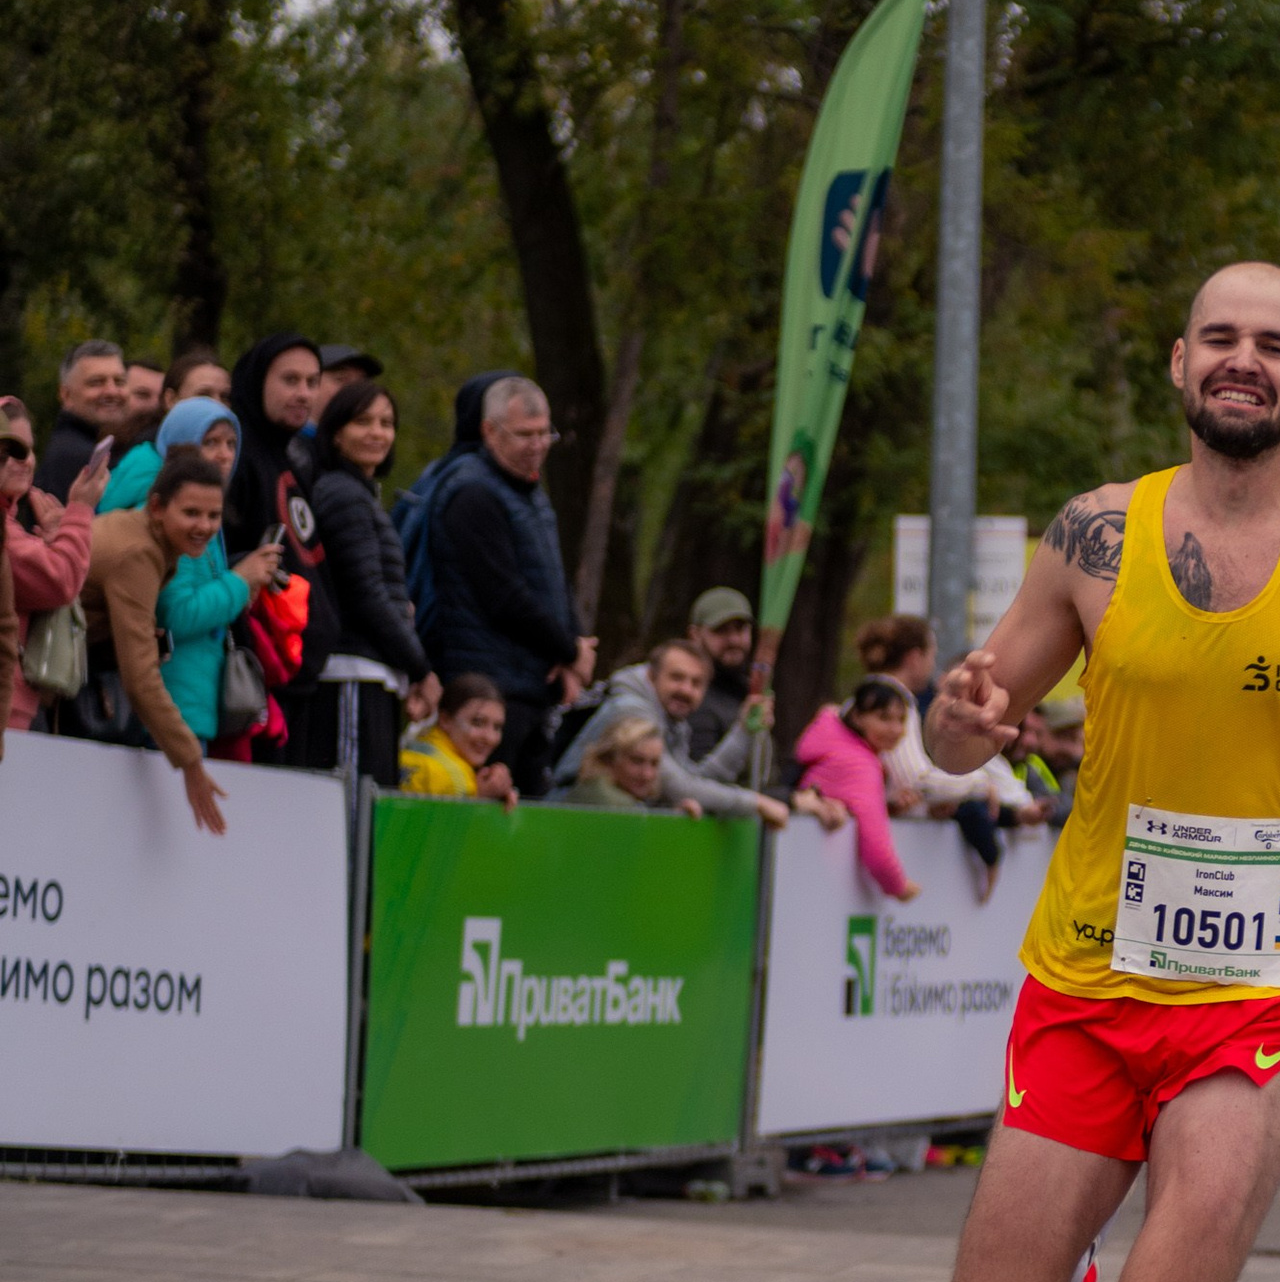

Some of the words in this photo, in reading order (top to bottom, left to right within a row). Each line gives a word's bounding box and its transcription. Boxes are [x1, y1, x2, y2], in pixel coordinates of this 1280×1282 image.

[1172, 824, 1212, 835] UNDER
[1172, 831, 1222, 843] ARMOUR
[1195, 868, 1236, 882] IronClub
[1193, 885, 1234, 899] Максим
[1153, 903, 1266, 952] 10501
[1166, 959, 1262, 978] ПриватБанк
[84, 963, 203, 1022] разом
[498, 960, 685, 1041] ПриватБанк
